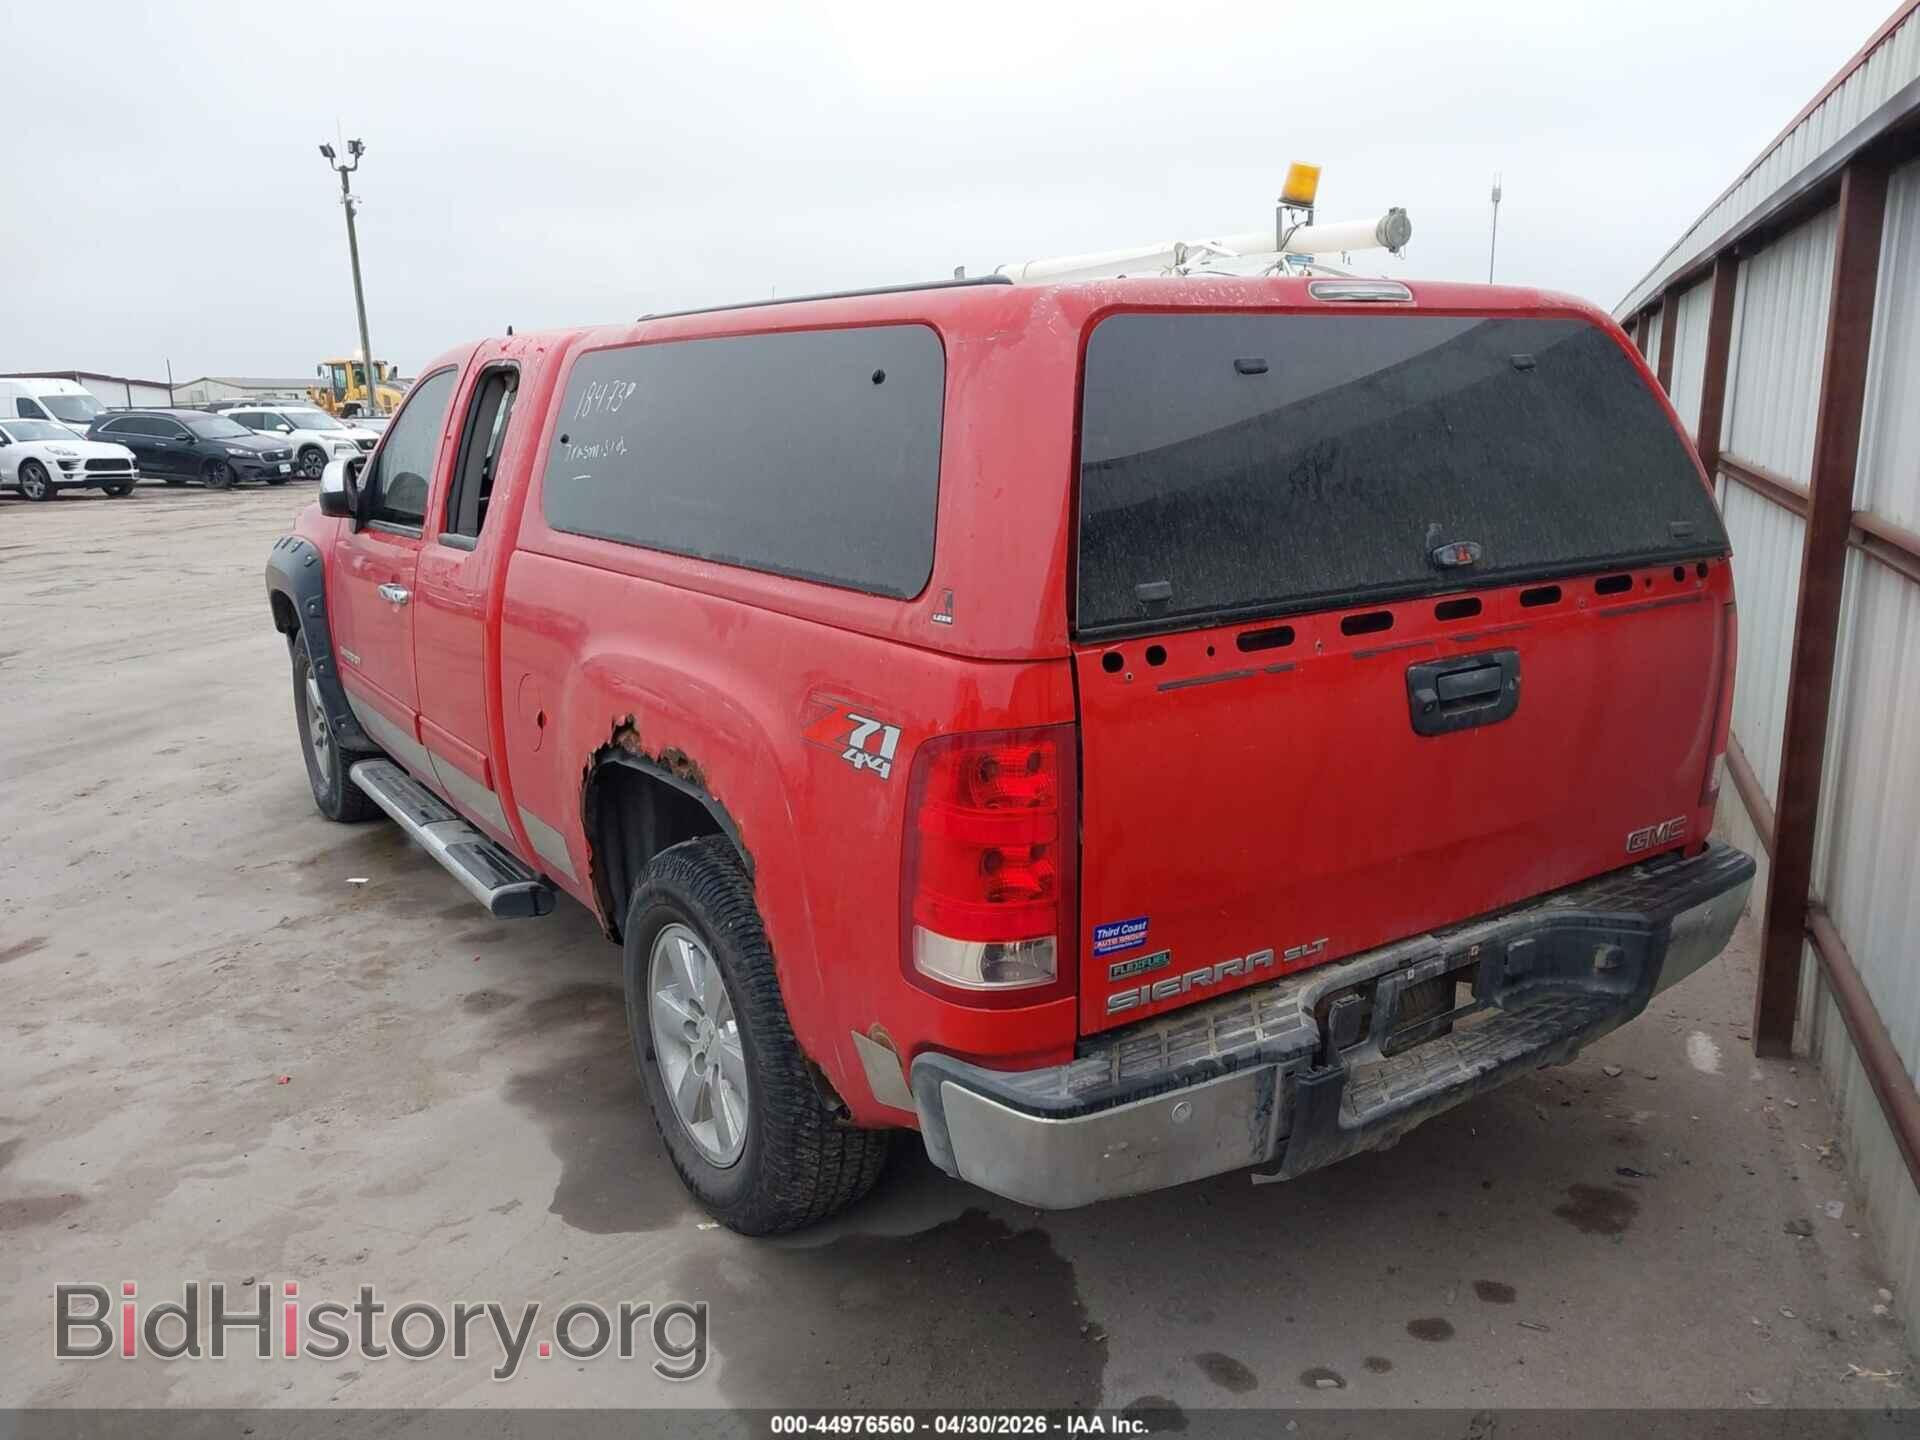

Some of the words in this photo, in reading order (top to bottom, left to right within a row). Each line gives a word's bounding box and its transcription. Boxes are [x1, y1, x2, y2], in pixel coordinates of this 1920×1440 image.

[1626, 815, 1687, 854] GMC
[1097, 926, 1120, 940] Third
[1121, 920, 1147, 934] Coast
[1107, 949, 1273, 1014] SIERRA
[1283, 938, 1329, 962] SLT
